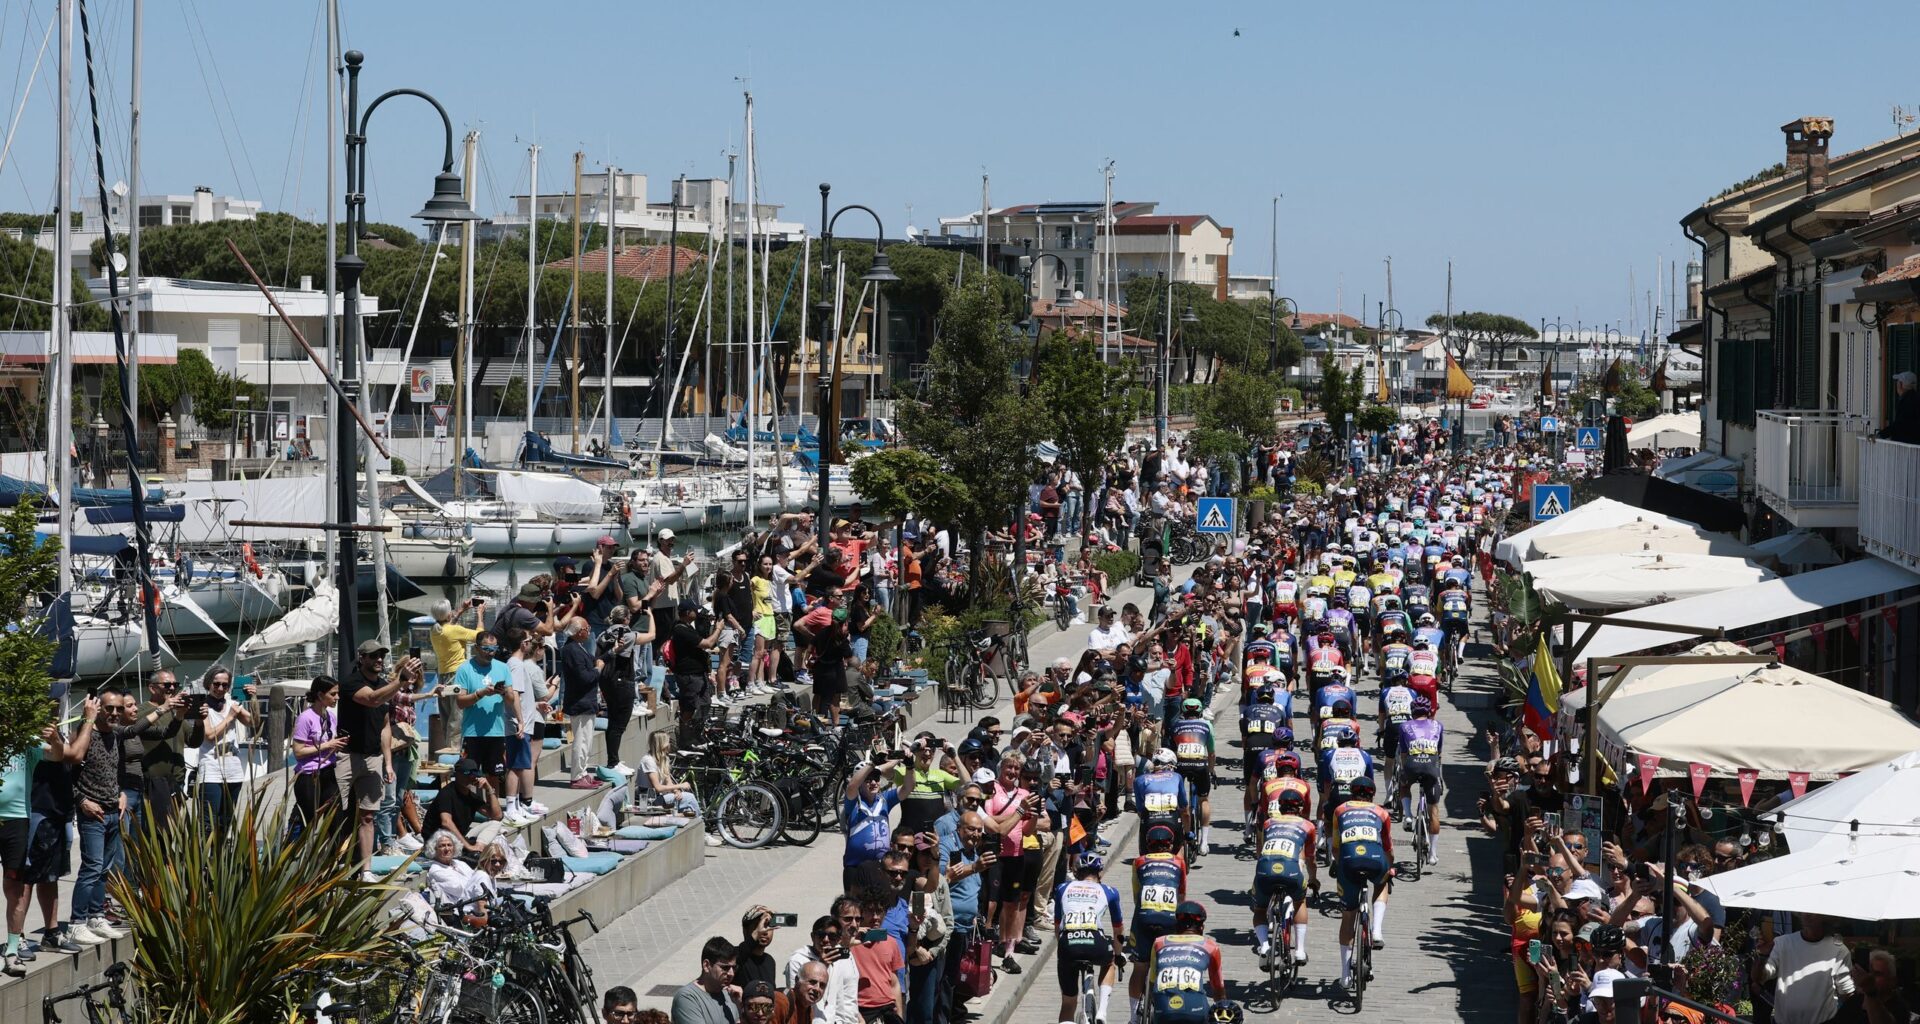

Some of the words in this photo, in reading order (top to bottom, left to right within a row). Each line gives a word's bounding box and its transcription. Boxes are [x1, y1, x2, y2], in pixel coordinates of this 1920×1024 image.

[1179, 745, 1188, 753] 37
[1193, 744, 1202, 753] 37
[1362, 827, 1374, 836] 68
[1264, 840, 1276, 850] 67
[1280, 841, 1292, 852] 67
[1144, 888, 1157, 902] 62
[1162, 890, 1175, 904] 62
[1067, 930, 1094, 939] BORA
[1183, 969, 1197, 983] 64
